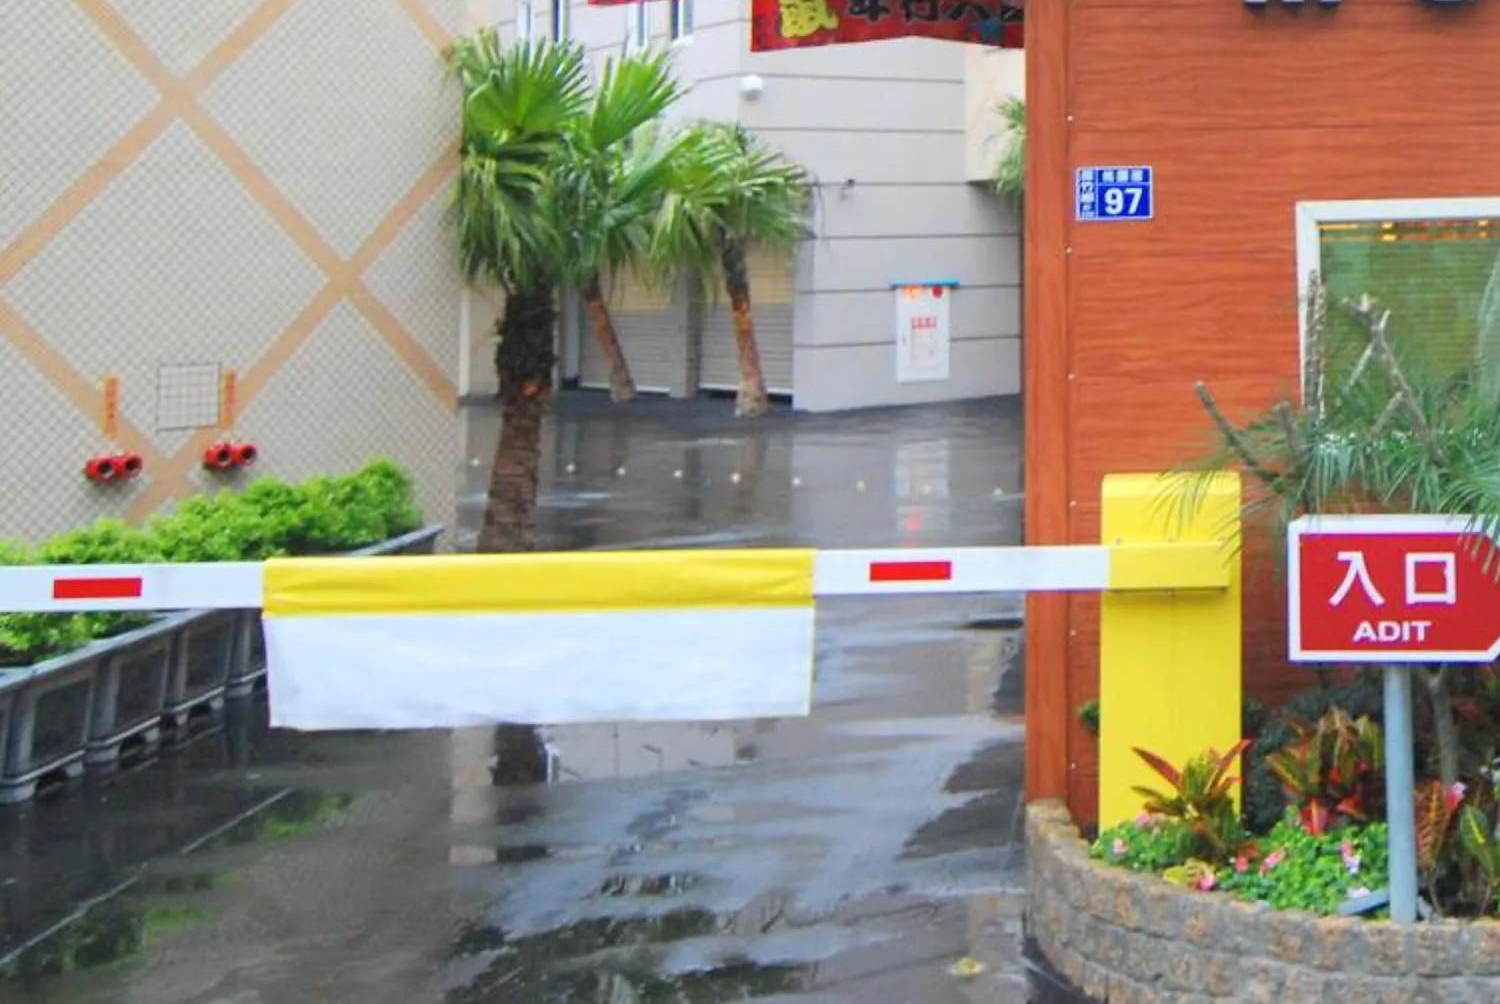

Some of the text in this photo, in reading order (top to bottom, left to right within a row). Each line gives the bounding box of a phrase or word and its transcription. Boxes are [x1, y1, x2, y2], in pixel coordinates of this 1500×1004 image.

[1104, 187, 1143, 215] 97
[1329, 551, 1456, 606] 入口
[1353, 621, 1432, 642] ADIT
